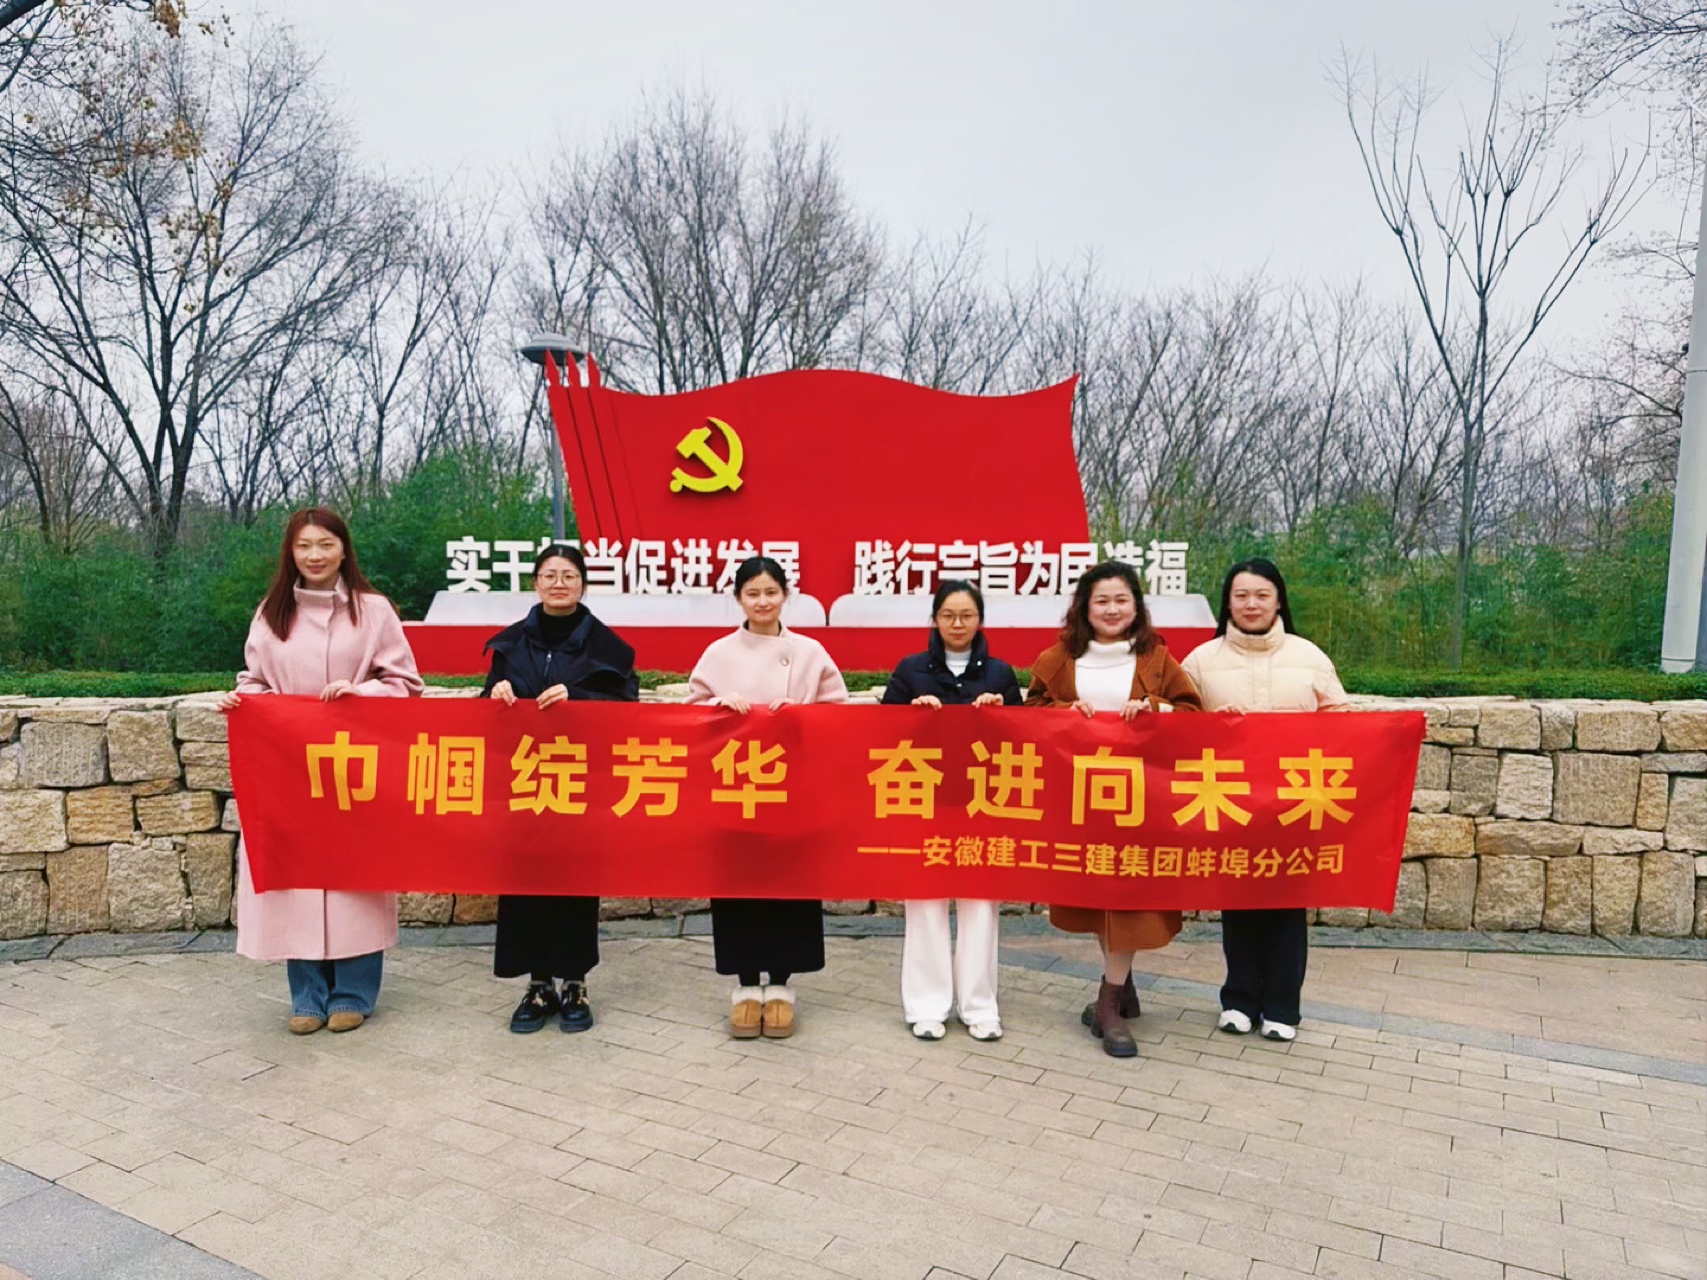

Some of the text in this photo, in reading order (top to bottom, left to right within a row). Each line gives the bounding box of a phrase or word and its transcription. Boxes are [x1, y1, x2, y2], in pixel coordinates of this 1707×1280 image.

[446, 536, 800, 594] 实干当促进发展
[305, 730, 1357, 831] 巾帼绽芳华 奋进向未来
